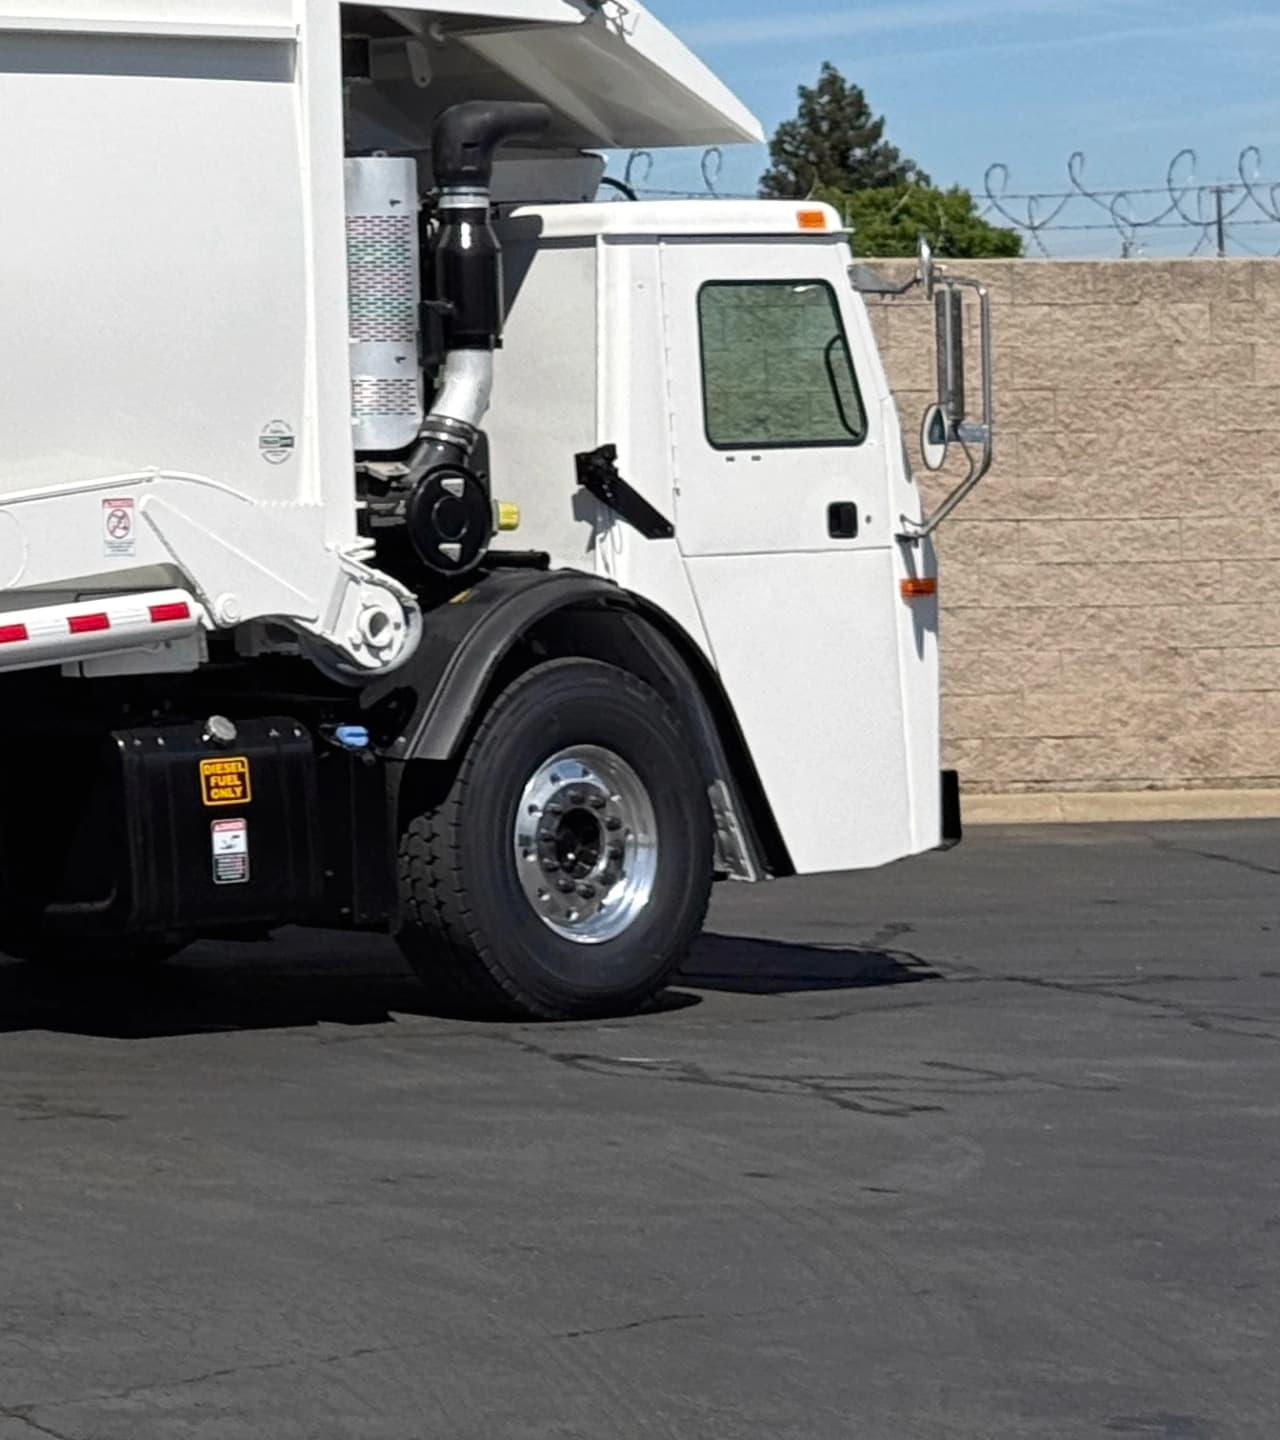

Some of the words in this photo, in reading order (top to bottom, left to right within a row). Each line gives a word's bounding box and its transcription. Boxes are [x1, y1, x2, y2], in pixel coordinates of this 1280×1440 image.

[203, 762, 246, 774] DIESEL
[209, 775, 242, 787] FUEL
[210, 786, 243, 800] ONLY
